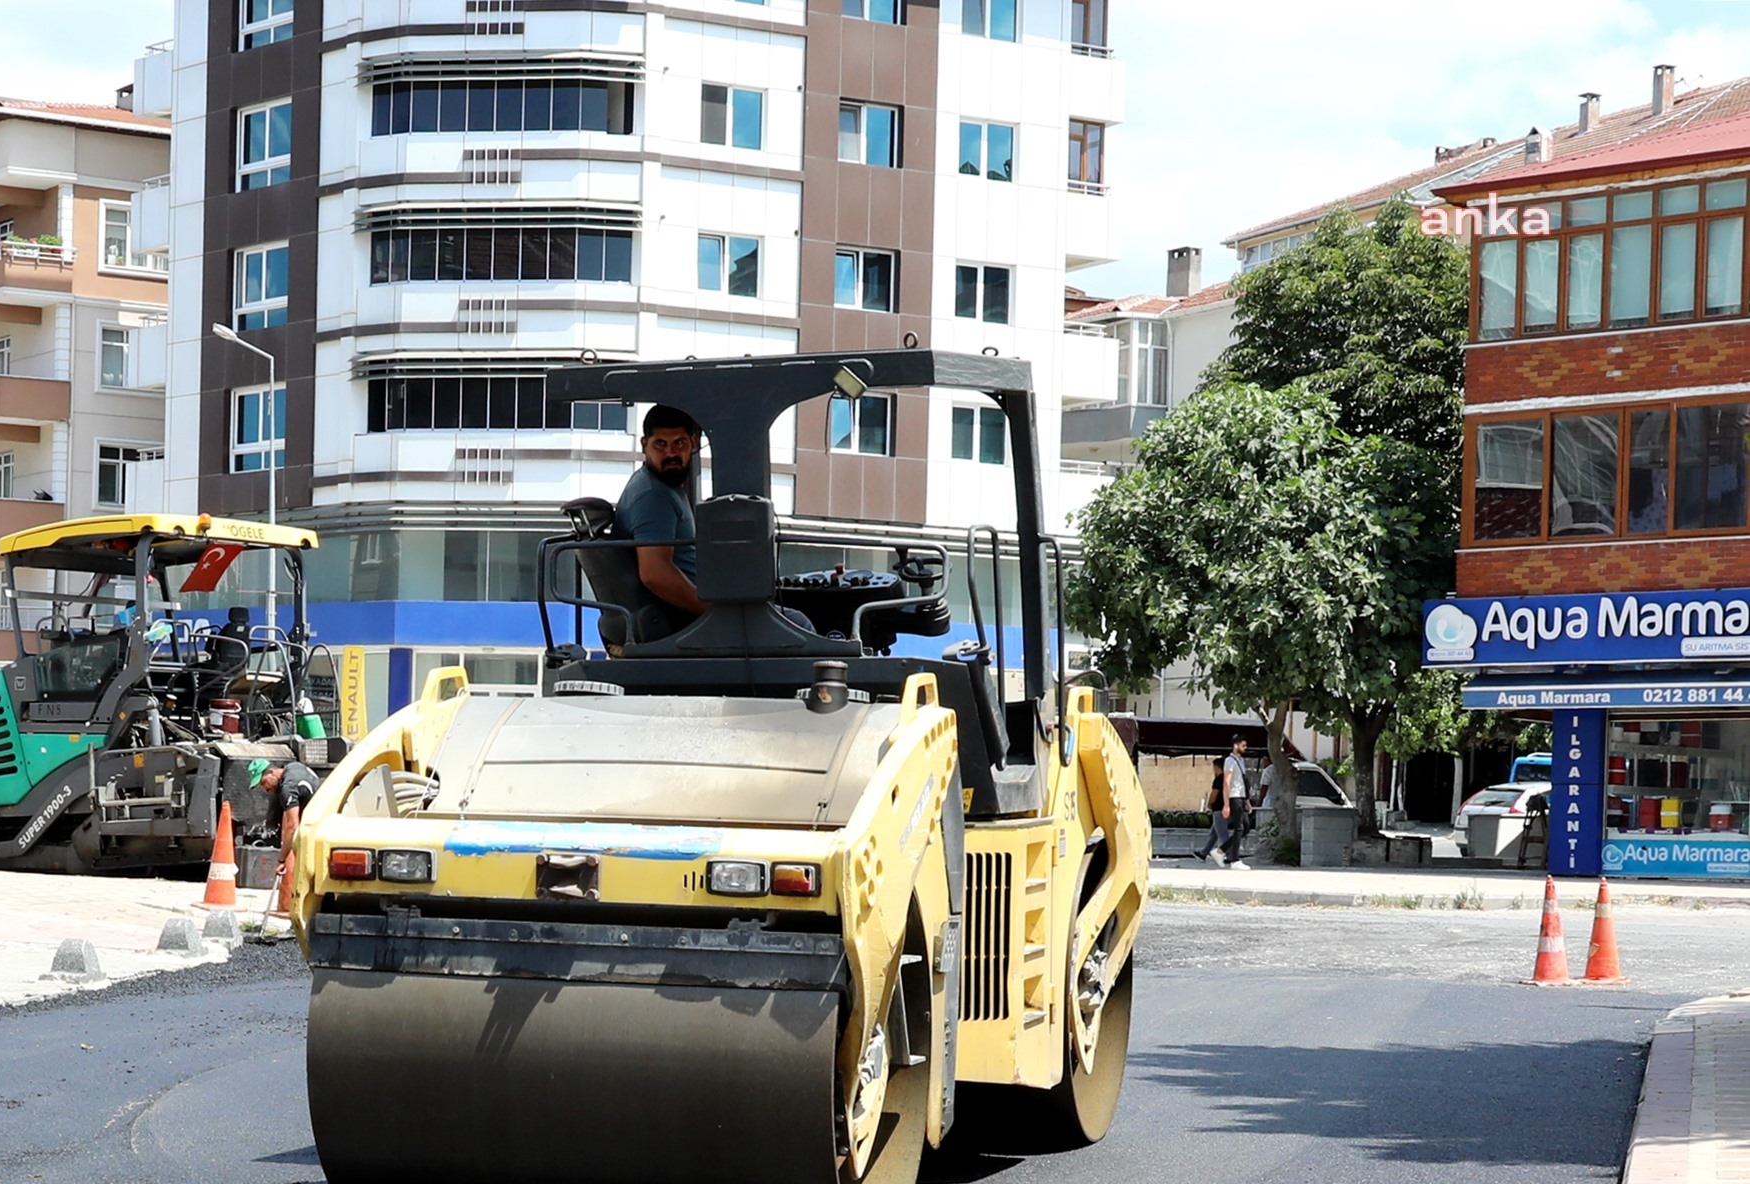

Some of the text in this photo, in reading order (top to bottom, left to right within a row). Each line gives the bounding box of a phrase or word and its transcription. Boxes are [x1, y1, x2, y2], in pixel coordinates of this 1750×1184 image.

[1481, 601, 1589, 650] Aqua
[1685, 643, 1697, 652] SU
[347, 651, 359, 741] ENAULT
[1497, 690, 1611, 706] Aqua Marmara
[1643, 689, 1683, 703] 0212
[1687, 688, 1717, 702] 881
[1722, 687, 1744, 701] 44
[18, 785, 72, 849] SUPER 1900-3
[1624, 843, 1750, 864] Aqua Marmara
